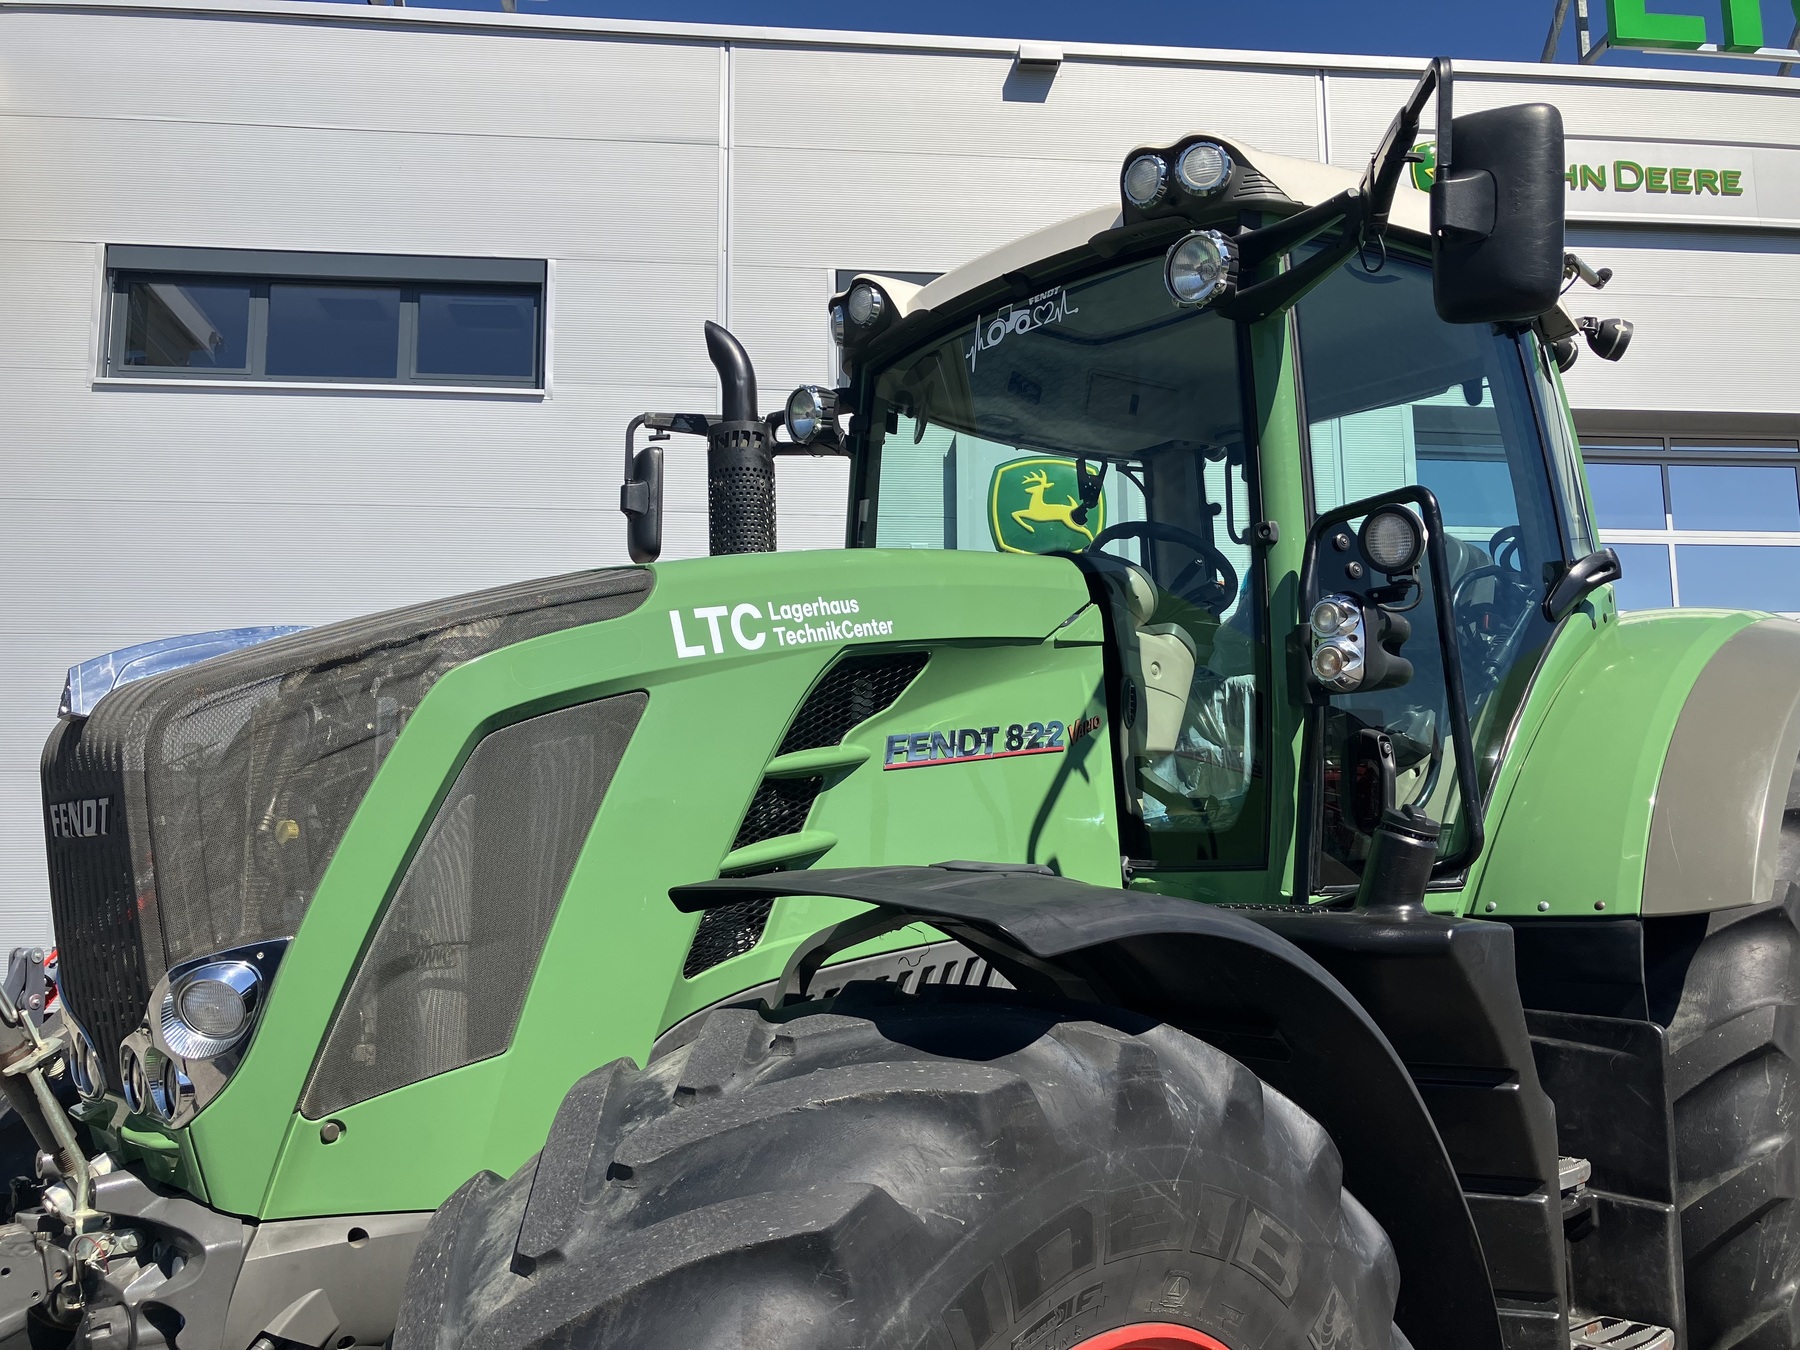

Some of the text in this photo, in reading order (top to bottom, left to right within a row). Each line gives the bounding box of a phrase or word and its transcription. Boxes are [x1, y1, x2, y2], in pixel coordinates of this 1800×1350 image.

[1613, 160, 1743, 196] DEERE
[1028, 285, 1061, 306] FENDT
[768, 596, 860, 623] Lagerhaus
[669, 603, 766, 659] LTC
[773, 619, 894, 647] TechnikCenter
[885, 726, 999, 765] FENDT
[1005, 720, 1064, 752] 822
[50, 797, 109, 838] FENDT
